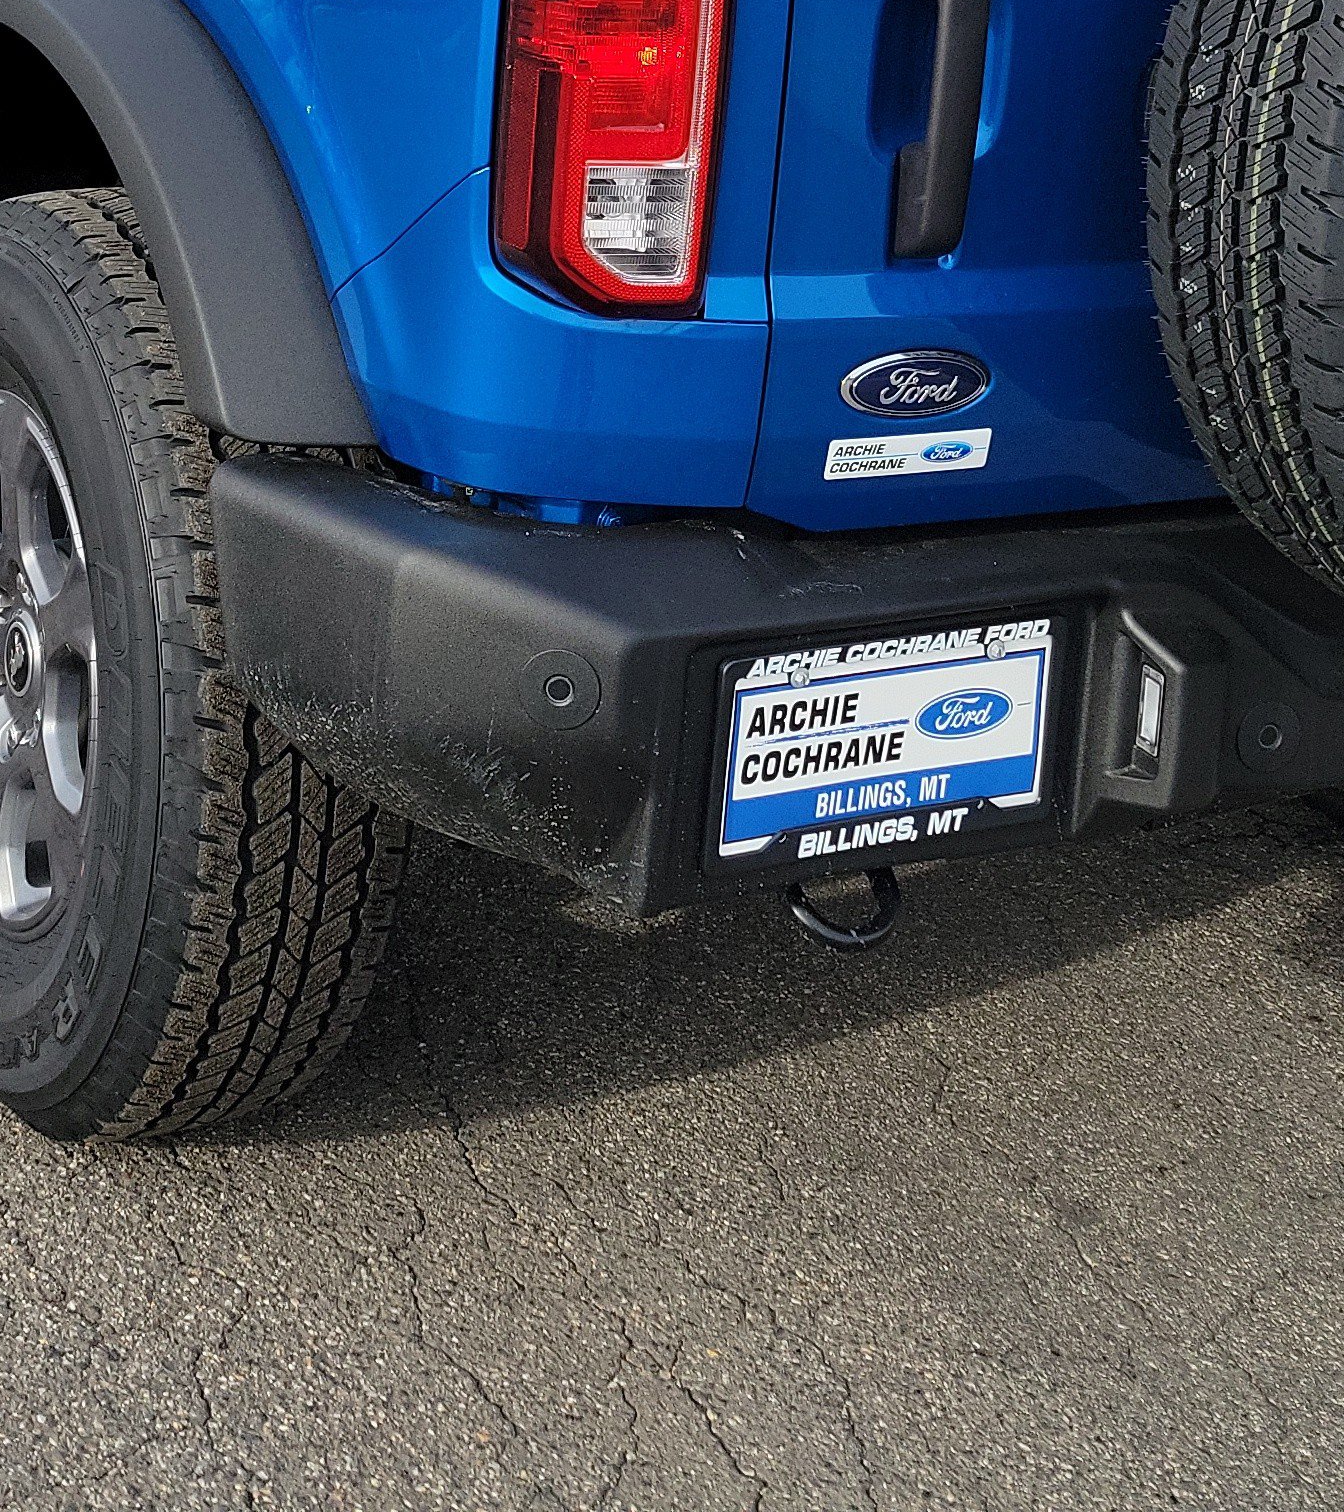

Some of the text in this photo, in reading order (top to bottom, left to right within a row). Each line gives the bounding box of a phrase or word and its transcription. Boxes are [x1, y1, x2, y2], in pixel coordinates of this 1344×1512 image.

[879, 368, 959, 404] Ford
[830, 458, 907, 474] COCHRANE
[833, 443, 886, 458] ARCHIE
[930, 443, 961, 460] Ford
[746, 619, 1051, 679] ARCHIE COCHRANE FORD
[746, 692, 860, 740] ARCHIE
[935, 696, 993, 731] Ford
[740, 731, 905, 786] COCHRANE
[815, 773, 951, 819] BILLINGS, MT
[797, 808, 968, 859] BILLINGS, MT
